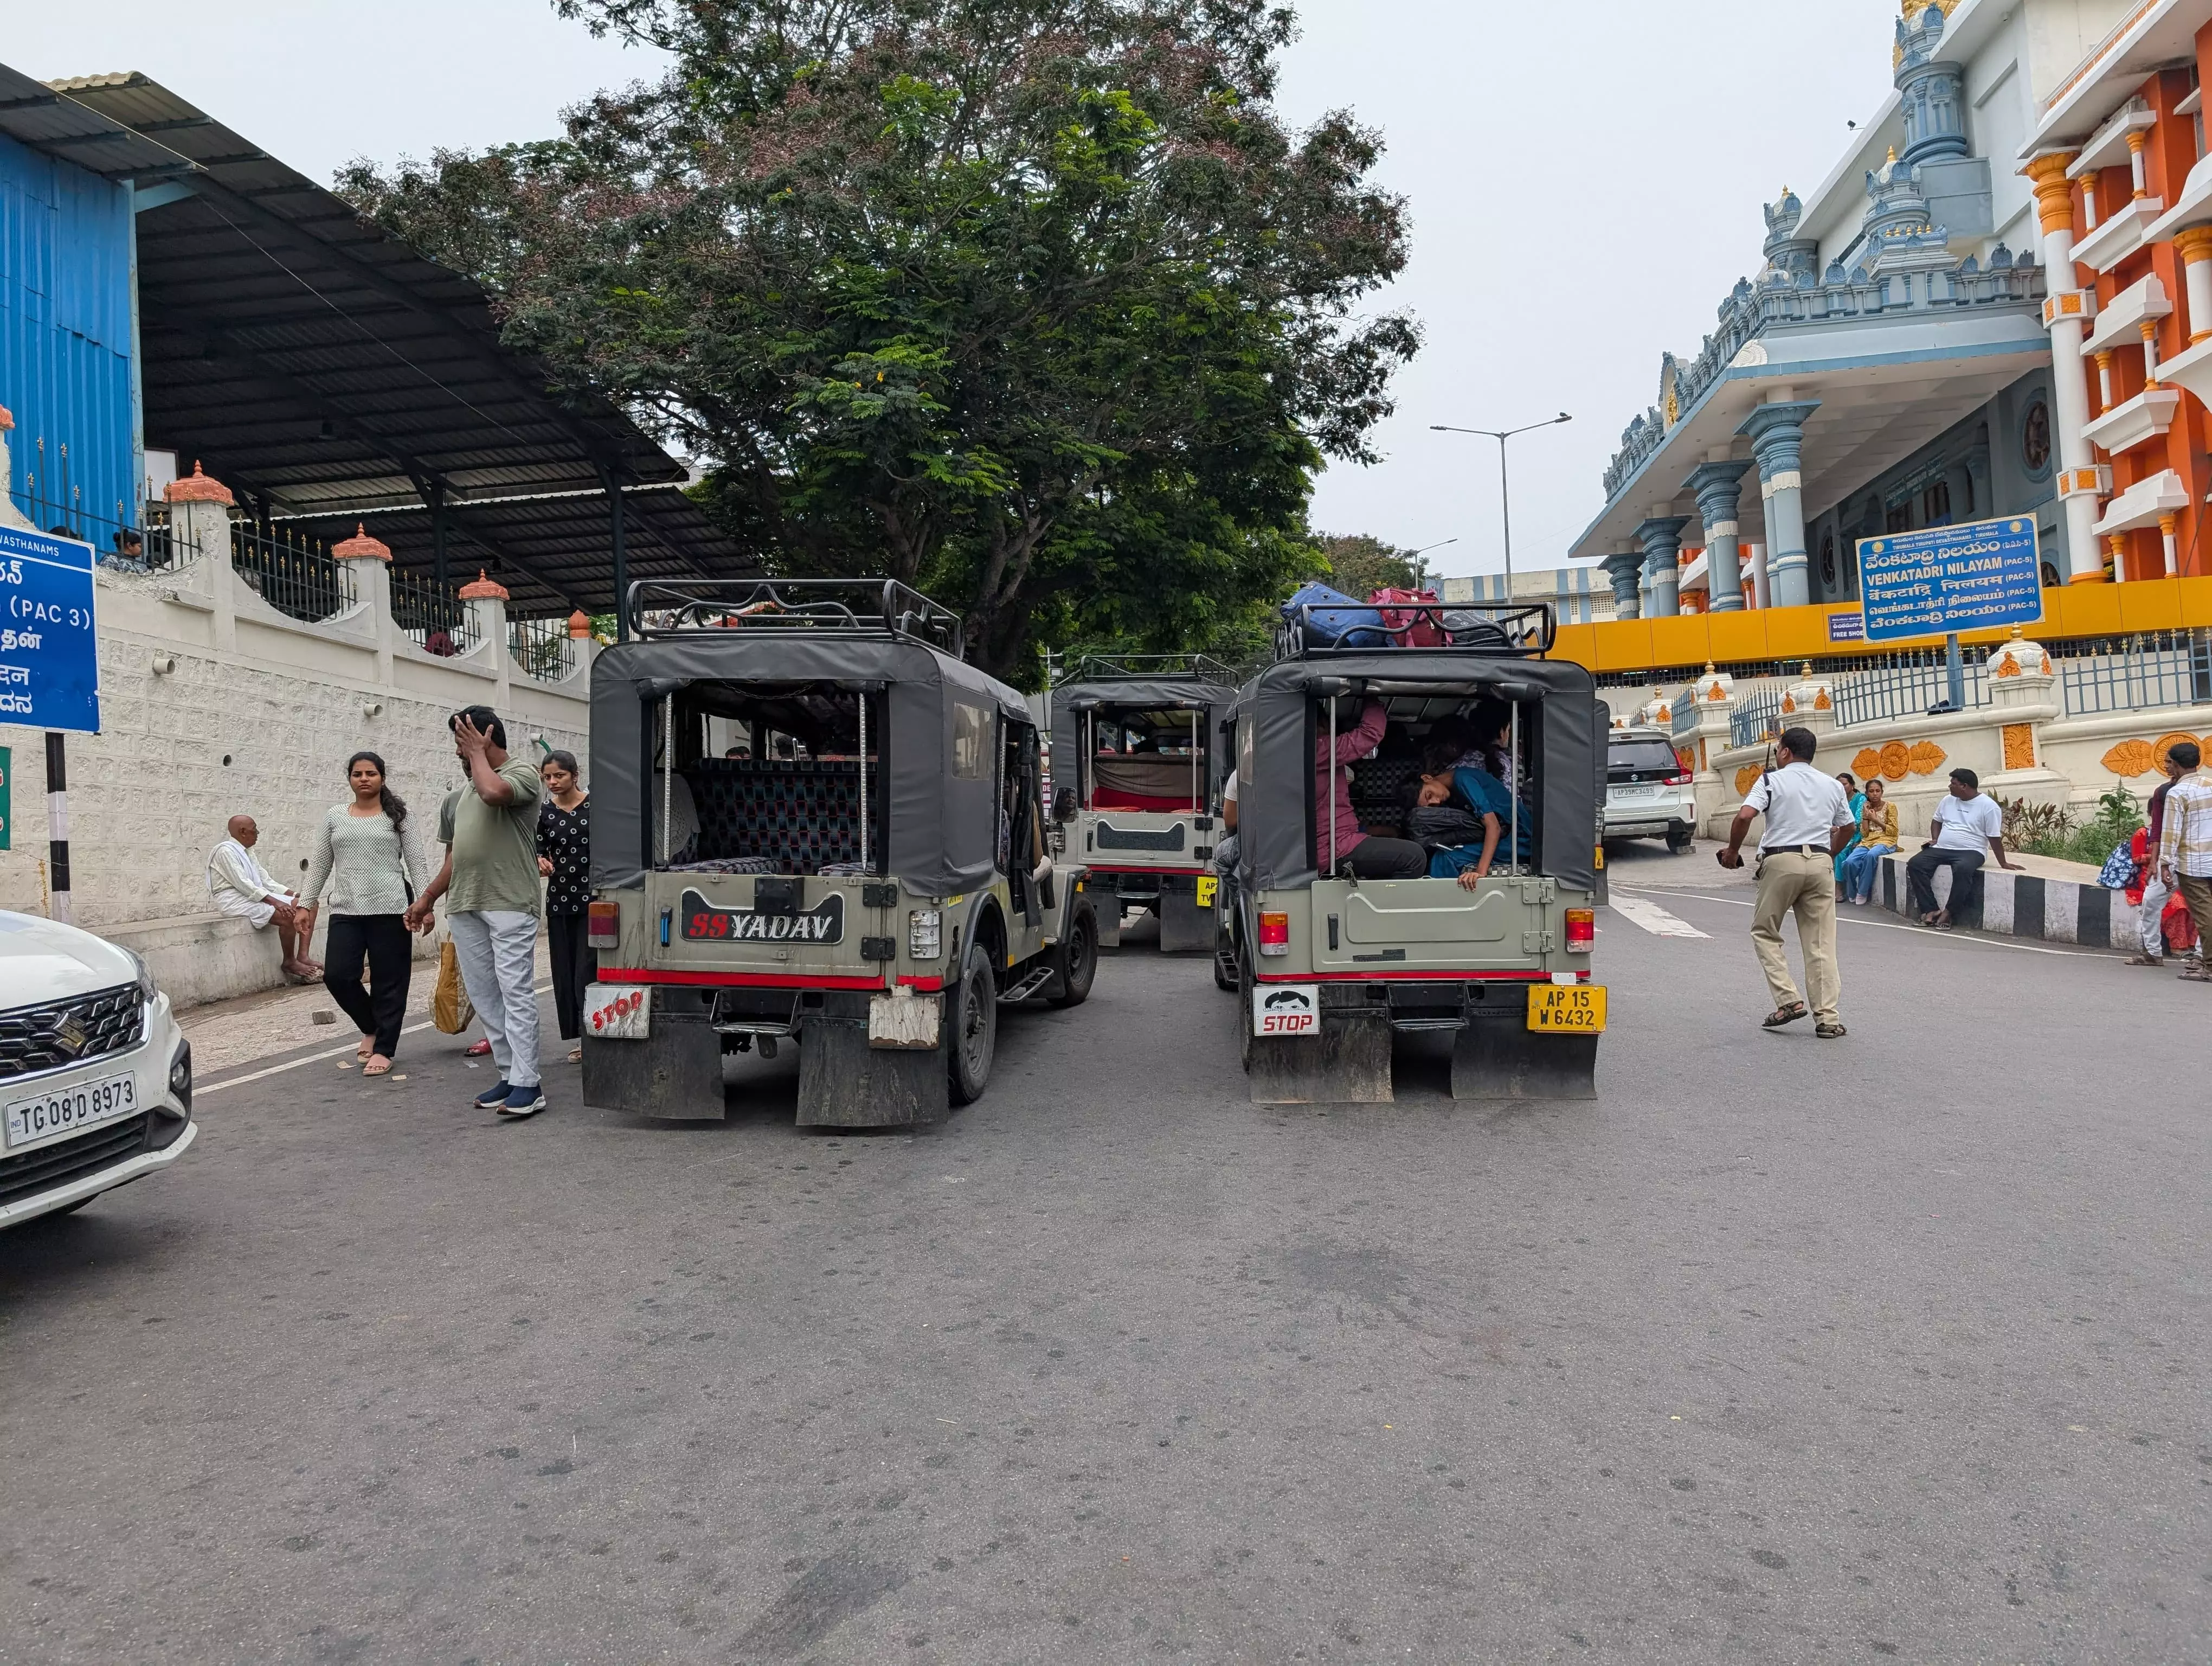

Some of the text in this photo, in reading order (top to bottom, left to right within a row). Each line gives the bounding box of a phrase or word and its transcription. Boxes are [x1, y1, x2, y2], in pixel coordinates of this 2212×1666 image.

[1936, 535, 1971, 543] DEVASTHANAMS
[1938, 541, 2001, 559] నిలయం
[1867, 556, 2033, 586] VENKATADRI NILAYAM (PAC-5)
[2005, 571, 2034, 582] (PAC-5)
[2007, 587, 2035, 597] (PAC-5)
[2008, 601, 2036, 611] (PAC-5)
[732, 915, 833, 939] YADAV
[1546, 991, 1589, 1007] AP 15
[592, 991, 644, 1031] STOP
[1540, 1009, 1594, 1026] W 6432
[1263, 1015, 1313, 1031] STOP
[10, 1119, 21, 1129] IND
